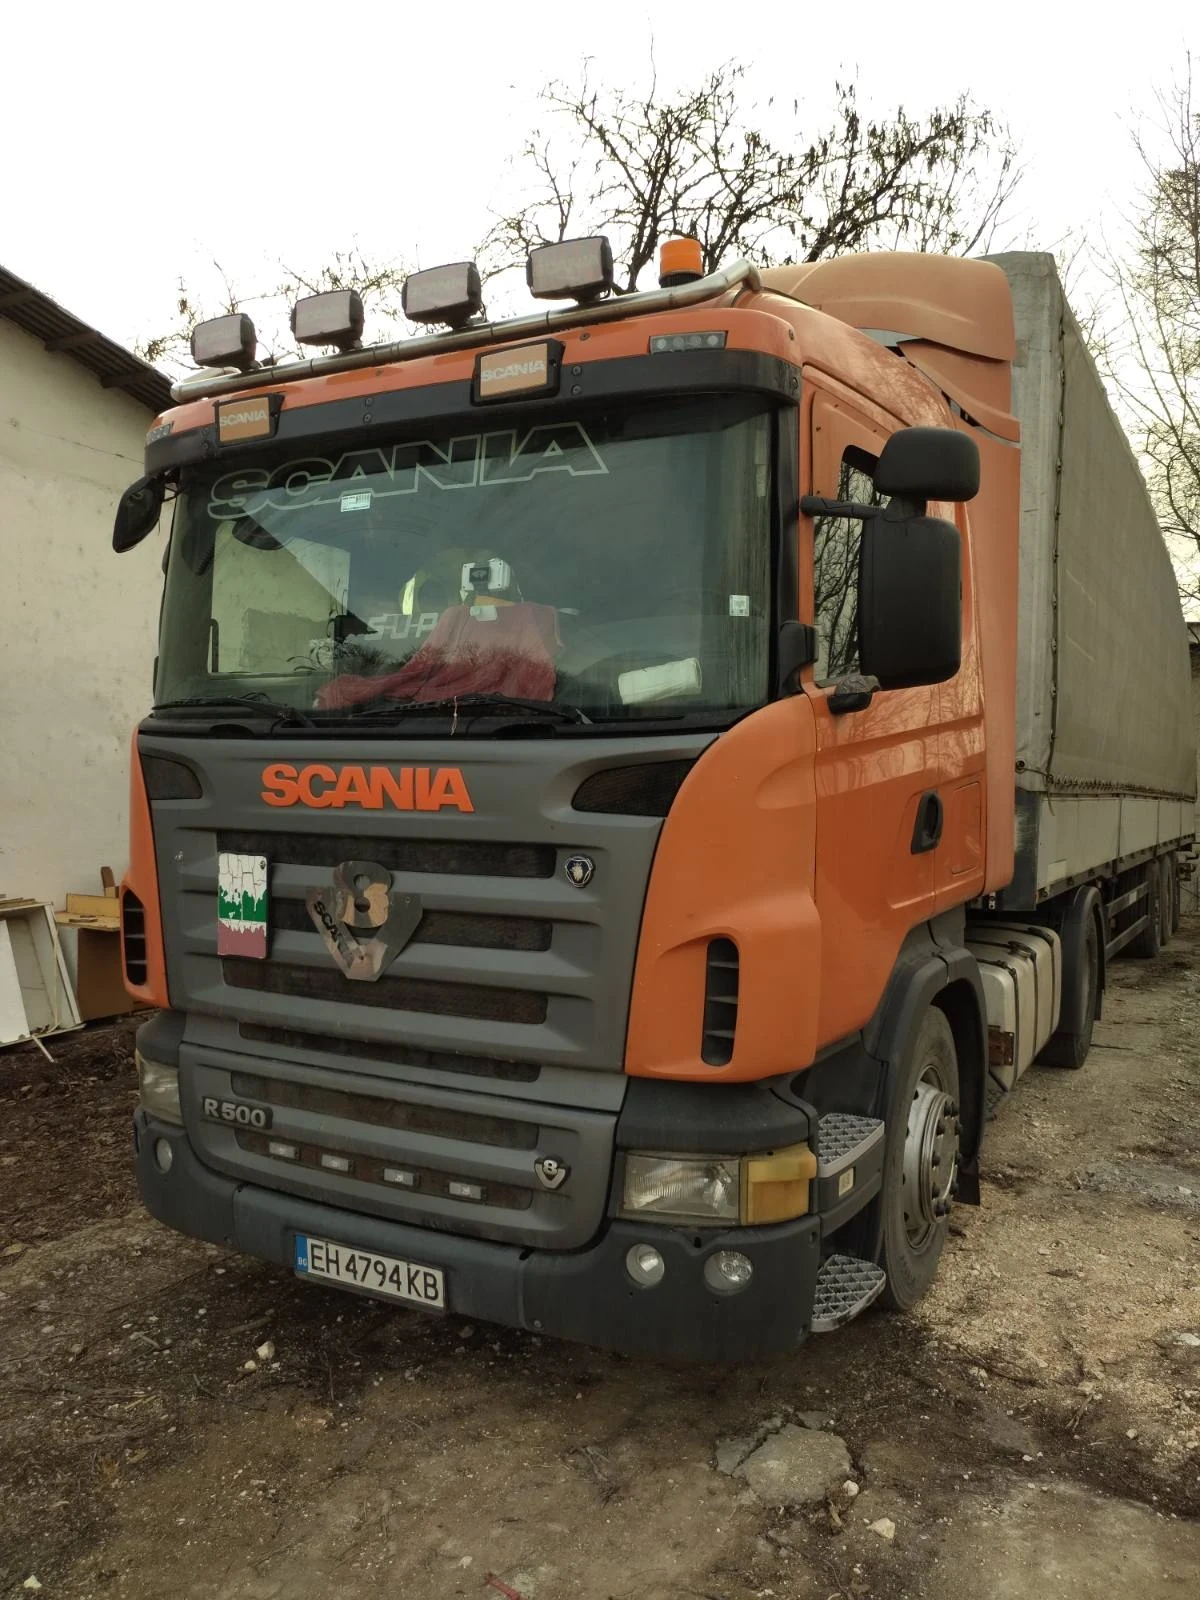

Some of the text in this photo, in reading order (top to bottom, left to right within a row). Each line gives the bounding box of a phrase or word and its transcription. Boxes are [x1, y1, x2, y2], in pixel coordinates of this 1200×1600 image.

[481, 360, 545, 382] SCANIA
[219, 410, 268, 427] SCANIA
[208, 422, 609, 519] SCANIA
[261, 763, 475, 812] SCANIA
[204, 1098, 266, 1128] R 500
[310, 1243, 439, 1301] EH 4794 KB
